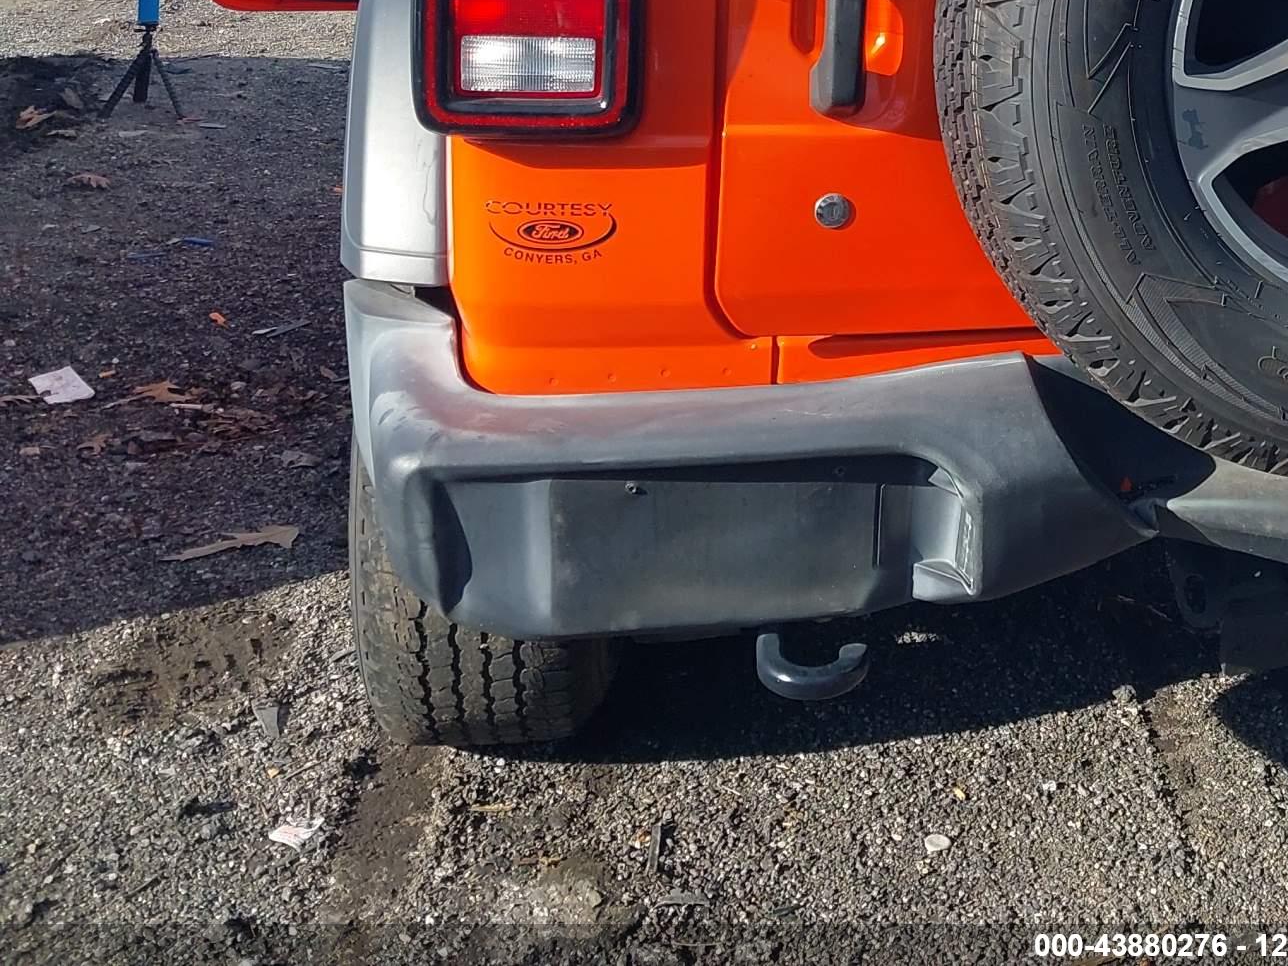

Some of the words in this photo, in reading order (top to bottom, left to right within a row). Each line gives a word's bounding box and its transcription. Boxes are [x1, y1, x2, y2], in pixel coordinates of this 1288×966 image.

[1082, 124, 1141, 266] ALL-TERRAIN
[1102, 124, 1157, 252] ADVENTURE
[485, 200, 613, 217] COURTESY
[530, 222, 570, 240] Ford
[503, 247, 578, 265] CONYERS,
[581, 249, 603, 262] GA
